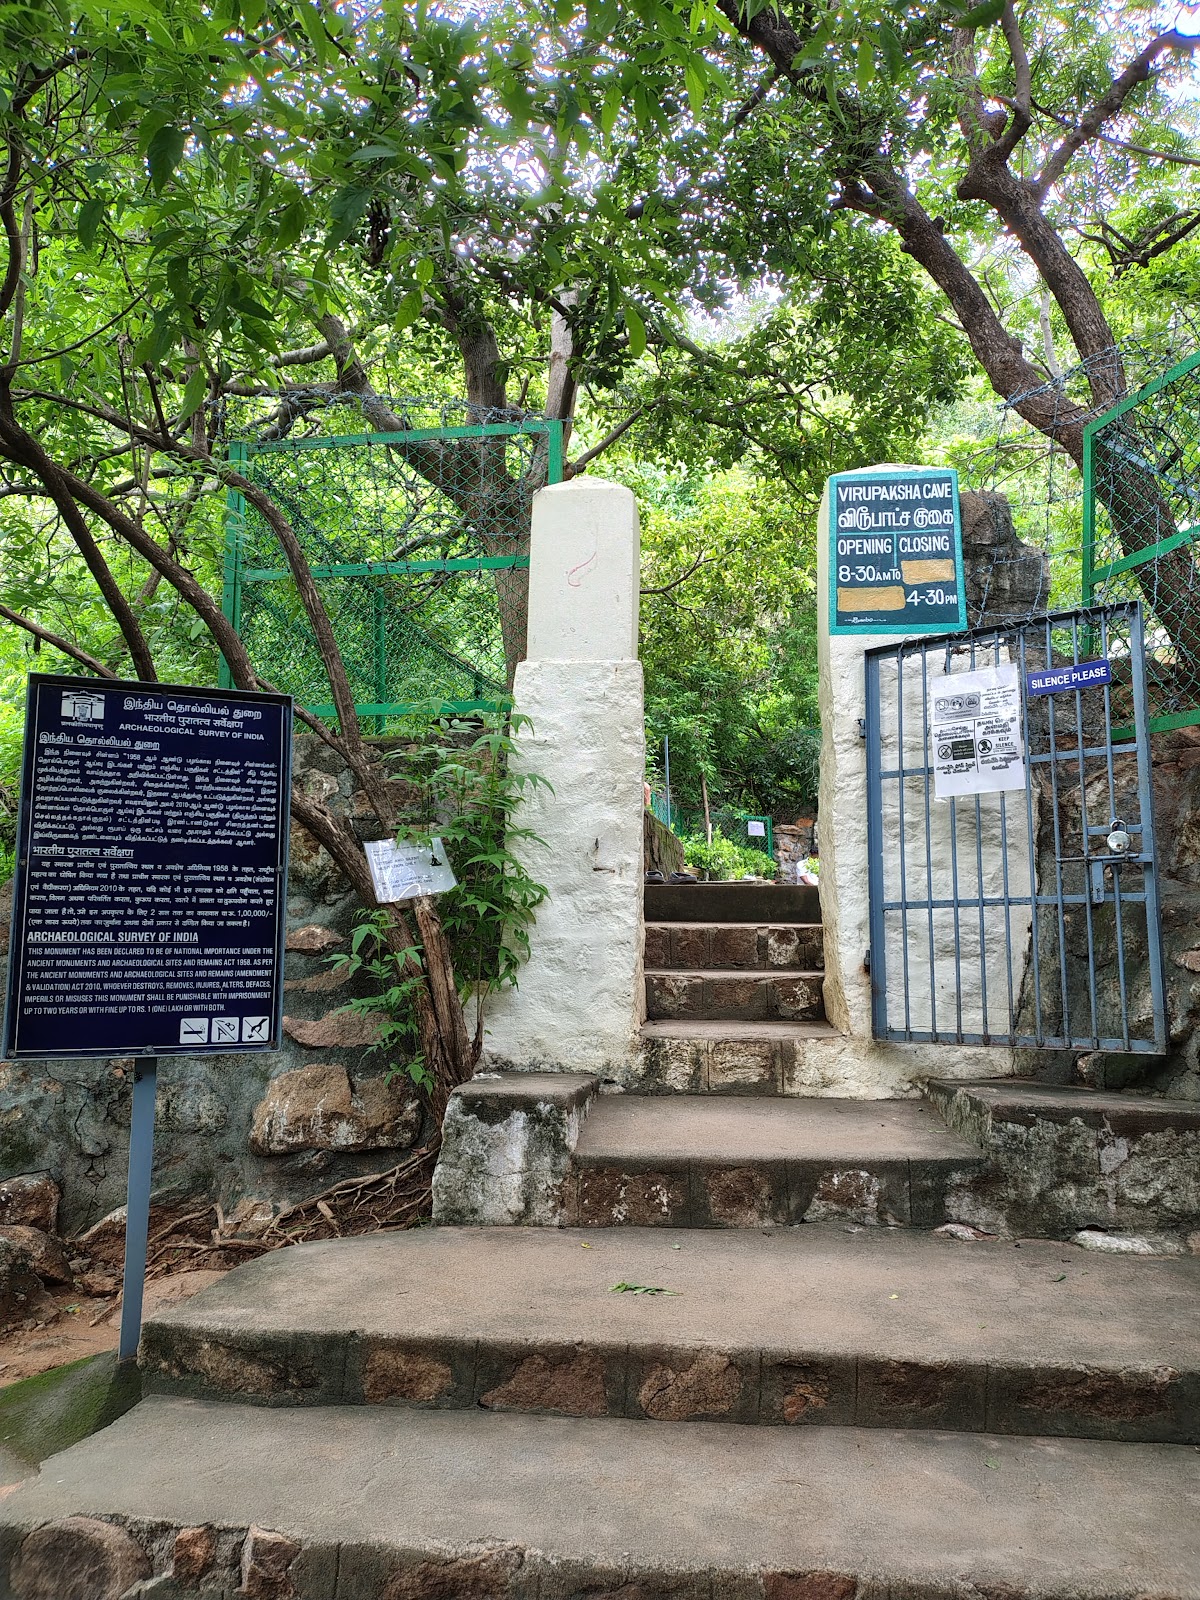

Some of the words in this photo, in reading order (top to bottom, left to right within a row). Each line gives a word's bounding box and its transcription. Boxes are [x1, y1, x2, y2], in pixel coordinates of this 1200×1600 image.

[838, 485, 921, 501] VIRUPAKSHA
[923, 483, 951, 499] CAVE
[914, 508, 953, 527] குகை
[838, 539, 892, 555] OPENING
[900, 536, 949, 552] CLOSING
[1032, 674, 1070, 689] SILENCE
[1072, 667, 1107, 683] PLEASE
[123, 697, 163, 710] இந்திய
[167, 701, 229, 715] தொல்லியல்
[233, 709, 262, 719] துறை
[144, 713, 176, 723] भारतीय
[178, 716, 210, 726] पुरातत्व
[213, 718, 243, 728] सर्वेक्षण
[119, 724, 194, 735] ARCHAEOLOGICAL
[198, 730, 230, 738] SURVEY
[39, 732, 73, 743] இந்திய
[77, 734, 131, 746] தொல்லியல்
[134, 740, 160, 750] துறை
[33, 844, 65, 855] भारतीय
[67, 847, 100, 858] पुरातत्व
[103, 846, 134, 857] सर्वेक्षण
[27, 932, 115, 942] ARCHAEOLOGICAL
[118, 932, 156, 942] SURVEY
[159, 932, 171, 941] OF
[174, 932, 198, 941] INDIA
